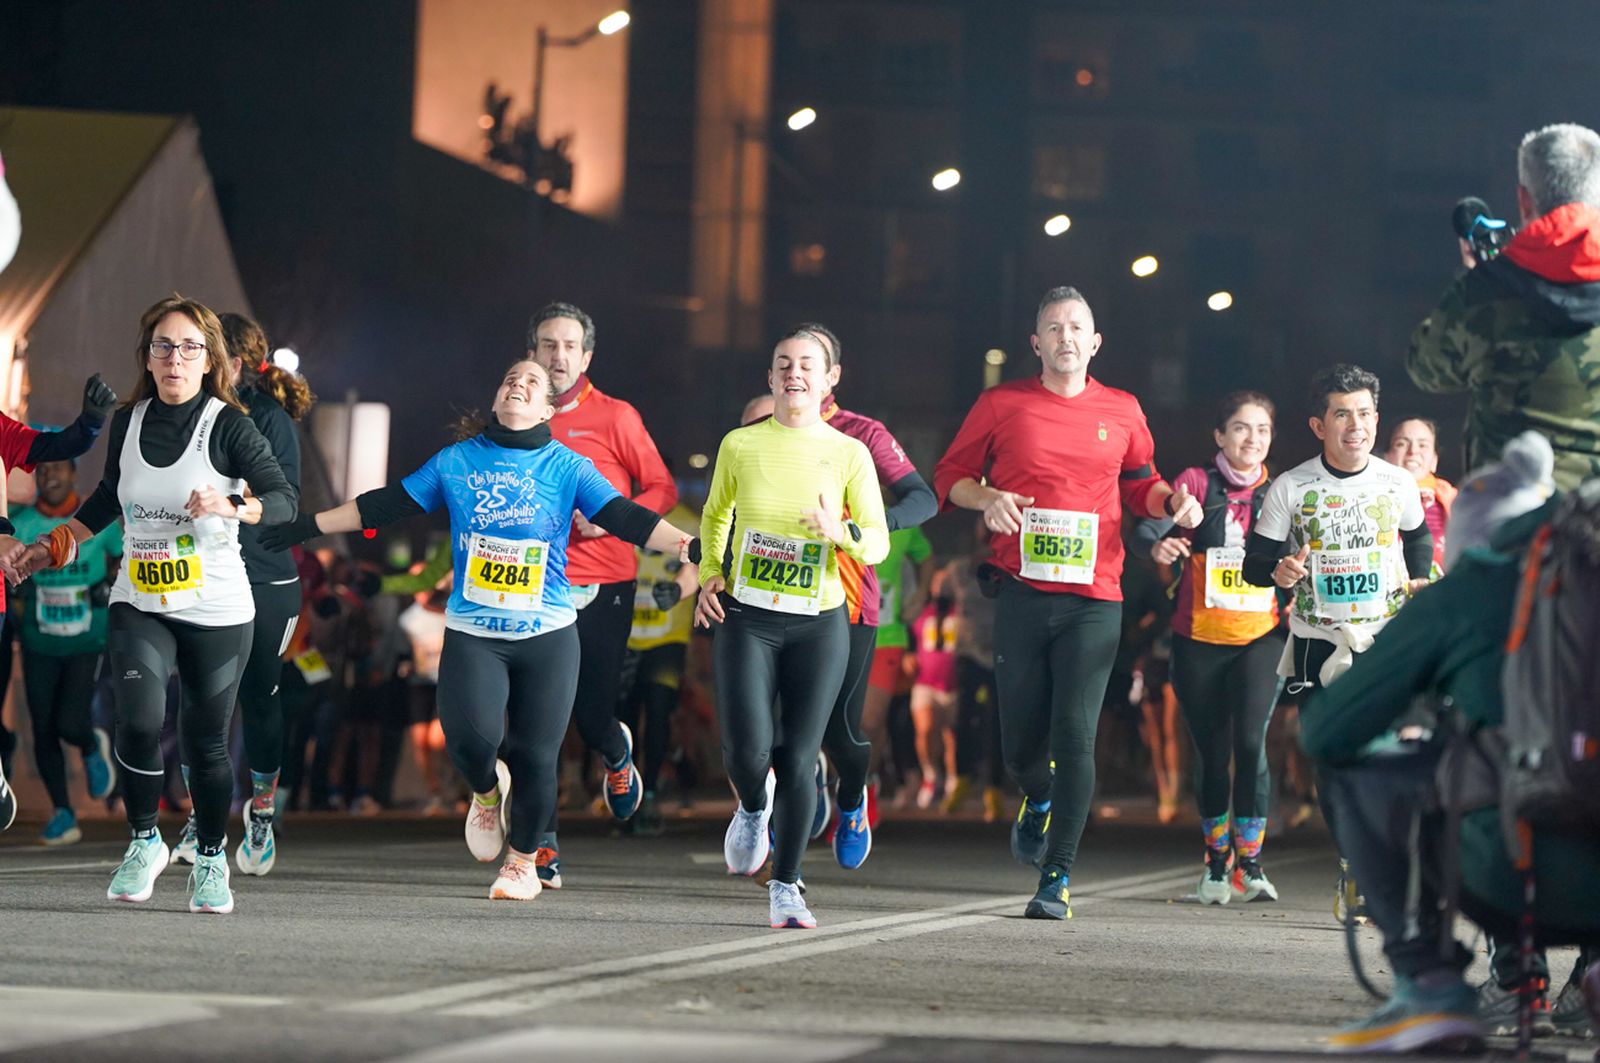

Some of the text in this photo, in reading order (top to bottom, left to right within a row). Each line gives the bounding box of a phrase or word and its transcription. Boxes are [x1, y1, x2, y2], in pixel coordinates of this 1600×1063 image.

[474, 484, 507, 514] 25
[1030, 525, 1044, 533] SAN
[1326, 515, 1367, 542] touch
[158, 541, 169, 550] DE
[487, 543, 510, 554] NOCHE
[510, 547, 519, 555] DE
[750, 545, 766, 557] SAN
[761, 538, 786, 552] NOCHE
[786, 543, 797, 552] DE
[1034, 534, 1084, 559] 5532
[477, 550, 491, 560] SAN
[1329, 557, 1350, 565] NOCHE
[137, 559, 189, 586] 4600
[480, 561, 530, 586] 4284
[750, 557, 813, 589] 12420
[1321, 566, 1335, 574] SAN
[1324, 572, 1379, 596] 13129
